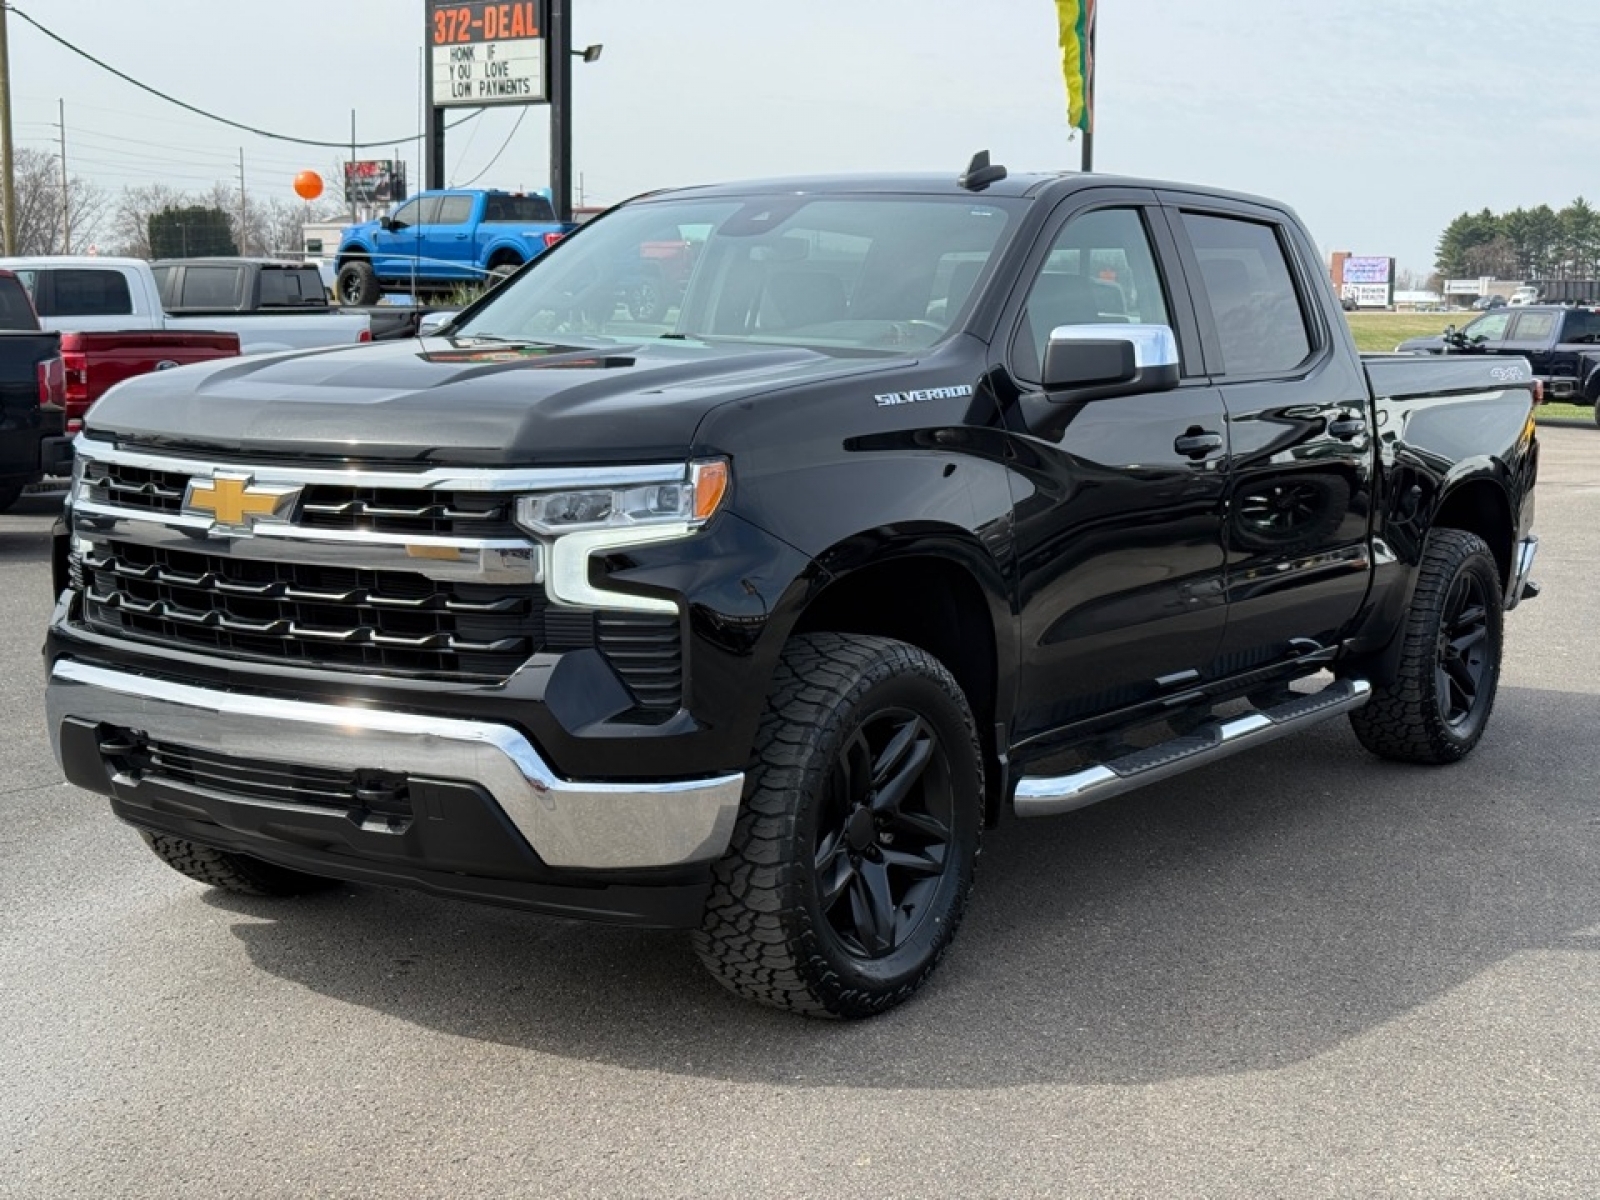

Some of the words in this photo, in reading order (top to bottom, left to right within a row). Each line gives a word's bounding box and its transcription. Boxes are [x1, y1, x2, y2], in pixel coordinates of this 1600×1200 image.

[434, 2, 538, 43] 372-DEAL
[450, 46, 475, 62] HONK
[486, 44, 495, 60] IF
[449, 63, 471, 80] YOU
[485, 61, 509, 78] LOVE
[452, 81, 472, 97] LOW
[479, 78, 531, 96] PAYMENTS
[875, 384, 972, 407] SILVERADO
